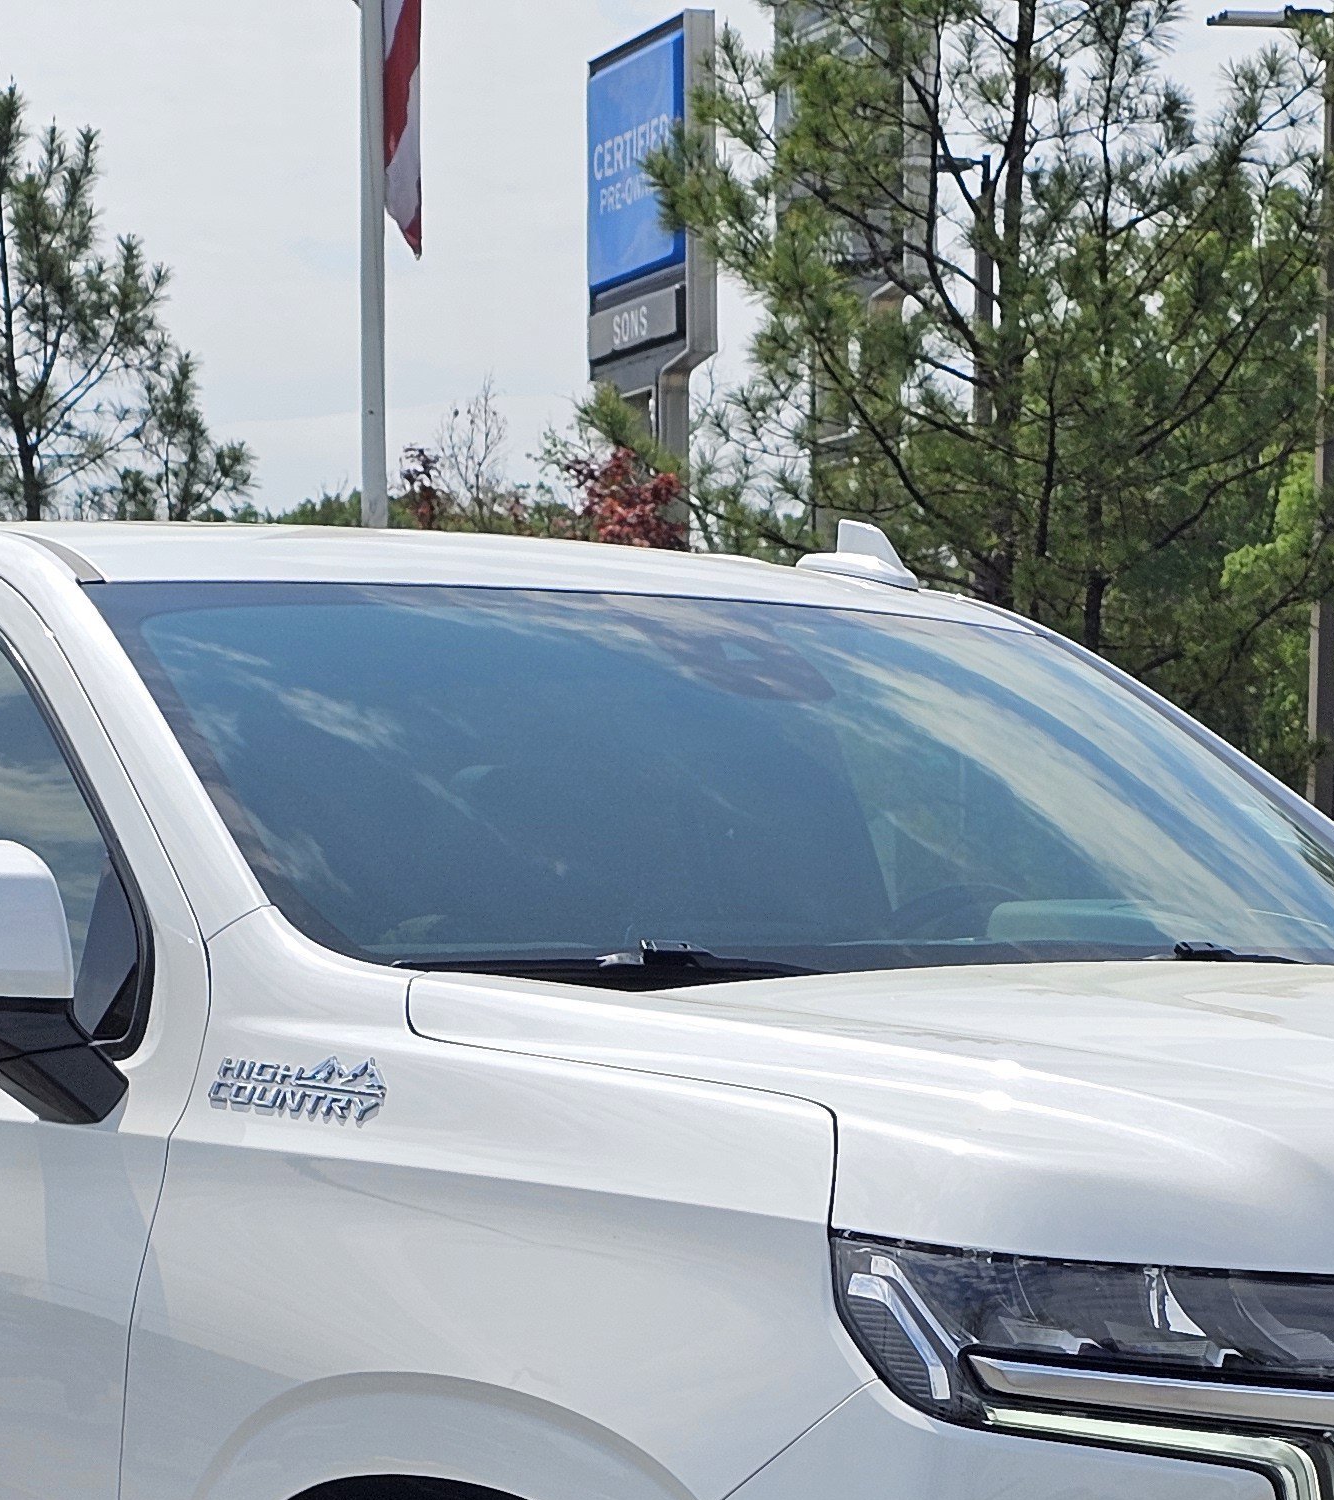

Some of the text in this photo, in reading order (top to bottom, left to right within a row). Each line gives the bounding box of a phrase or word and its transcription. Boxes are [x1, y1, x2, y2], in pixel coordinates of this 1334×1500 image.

[613, 305, 648, 345] SONS
[218, 1057, 304, 1086] HIGH
[208, 1081, 380, 1121] COUNTRY
